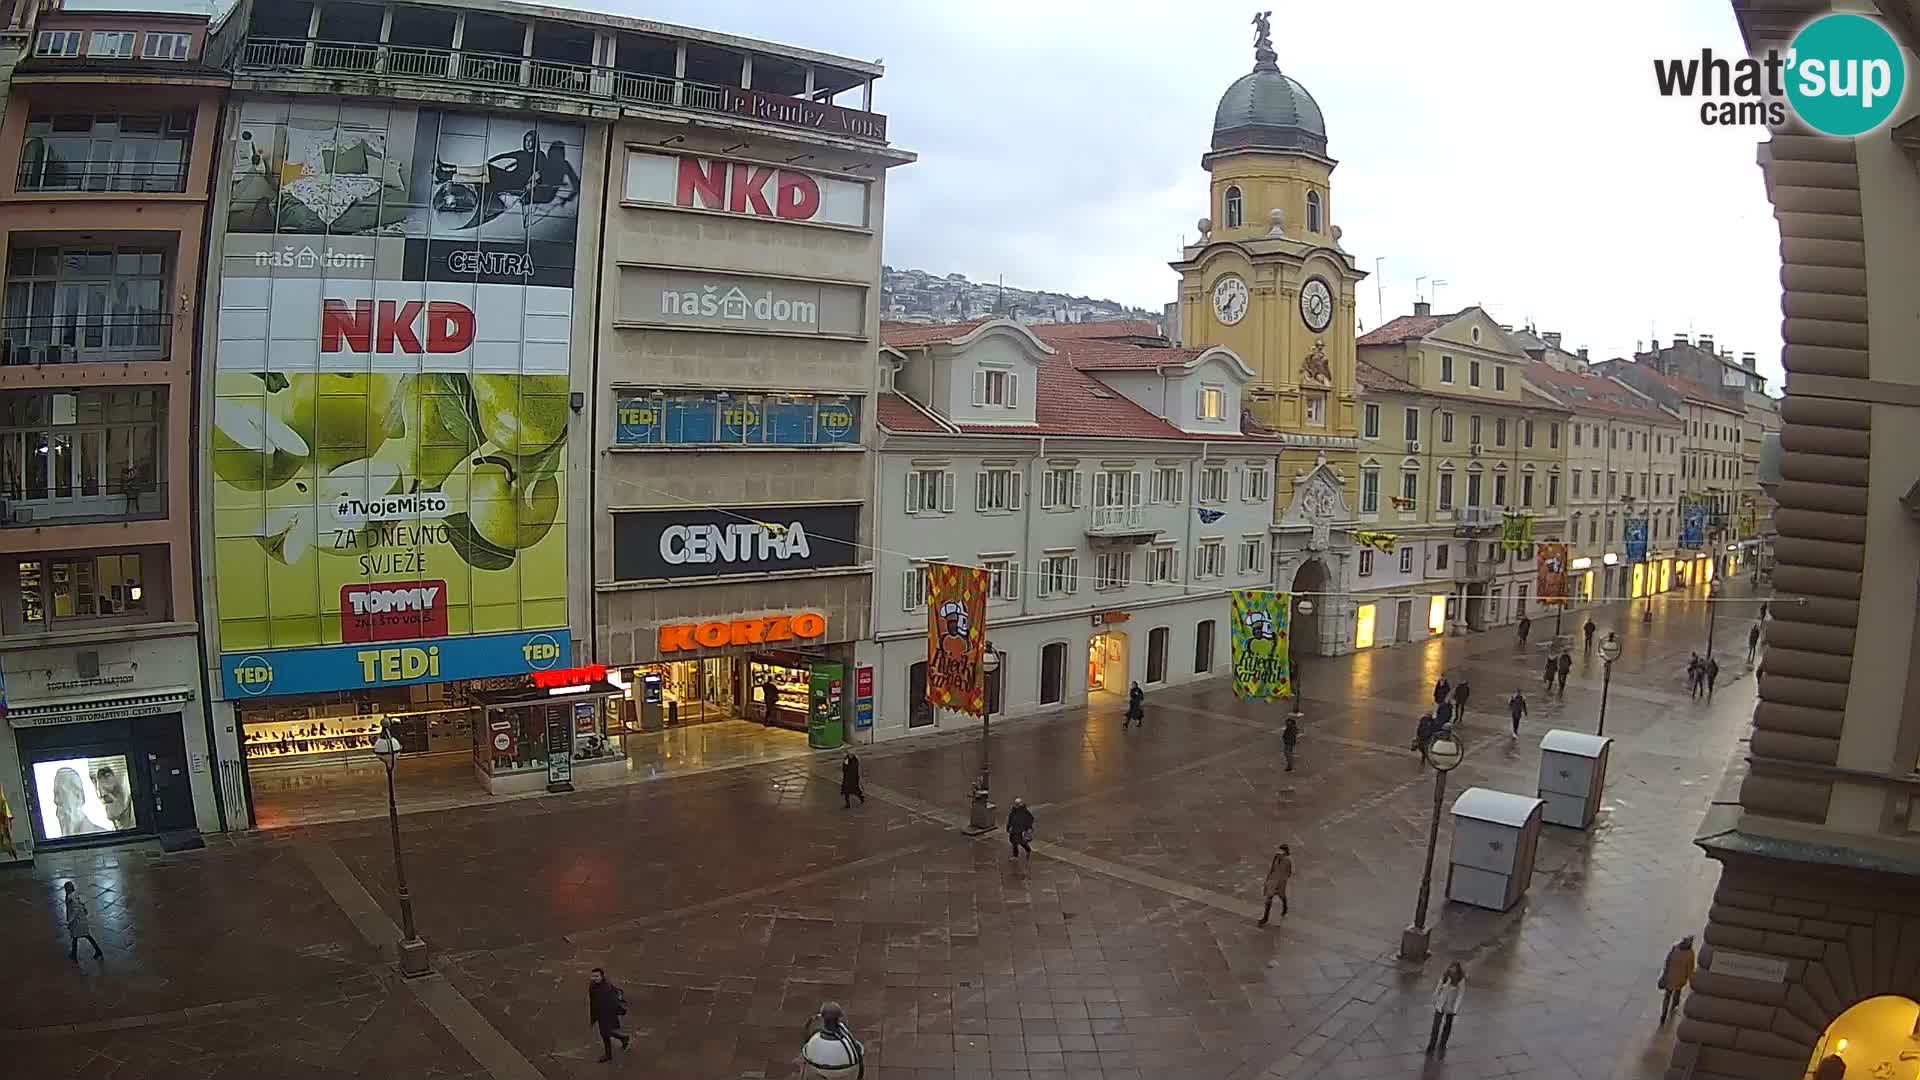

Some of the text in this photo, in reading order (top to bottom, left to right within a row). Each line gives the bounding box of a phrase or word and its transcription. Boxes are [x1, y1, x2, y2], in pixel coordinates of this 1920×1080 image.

[723, 89, 745, 112] Le
[676, 158, 820, 220] NKD
[255, 246, 365, 269] naš dom
[449, 250, 535, 276] CENTRA
[661, 284, 816, 324] naš dom
[320, 298, 477, 354] NKD
[618, 408, 658, 426] TEDi
[723, 409, 761, 426] TEDi
[819, 411, 853, 427] TEDi
[338, 498, 446, 517] #TvojeMisto
[334, 524, 450, 549] ZA DNEVNO
[659, 521, 811, 565] CENTRA
[359, 547, 426, 576] SVJEŽE
[348, 586, 439, 615] TOMMY
[658, 613, 826, 652] KORZO
[357, 646, 441, 683] TEDi
[521, 644, 560, 661] TEDi
[234, 666, 274, 685] TEDi
